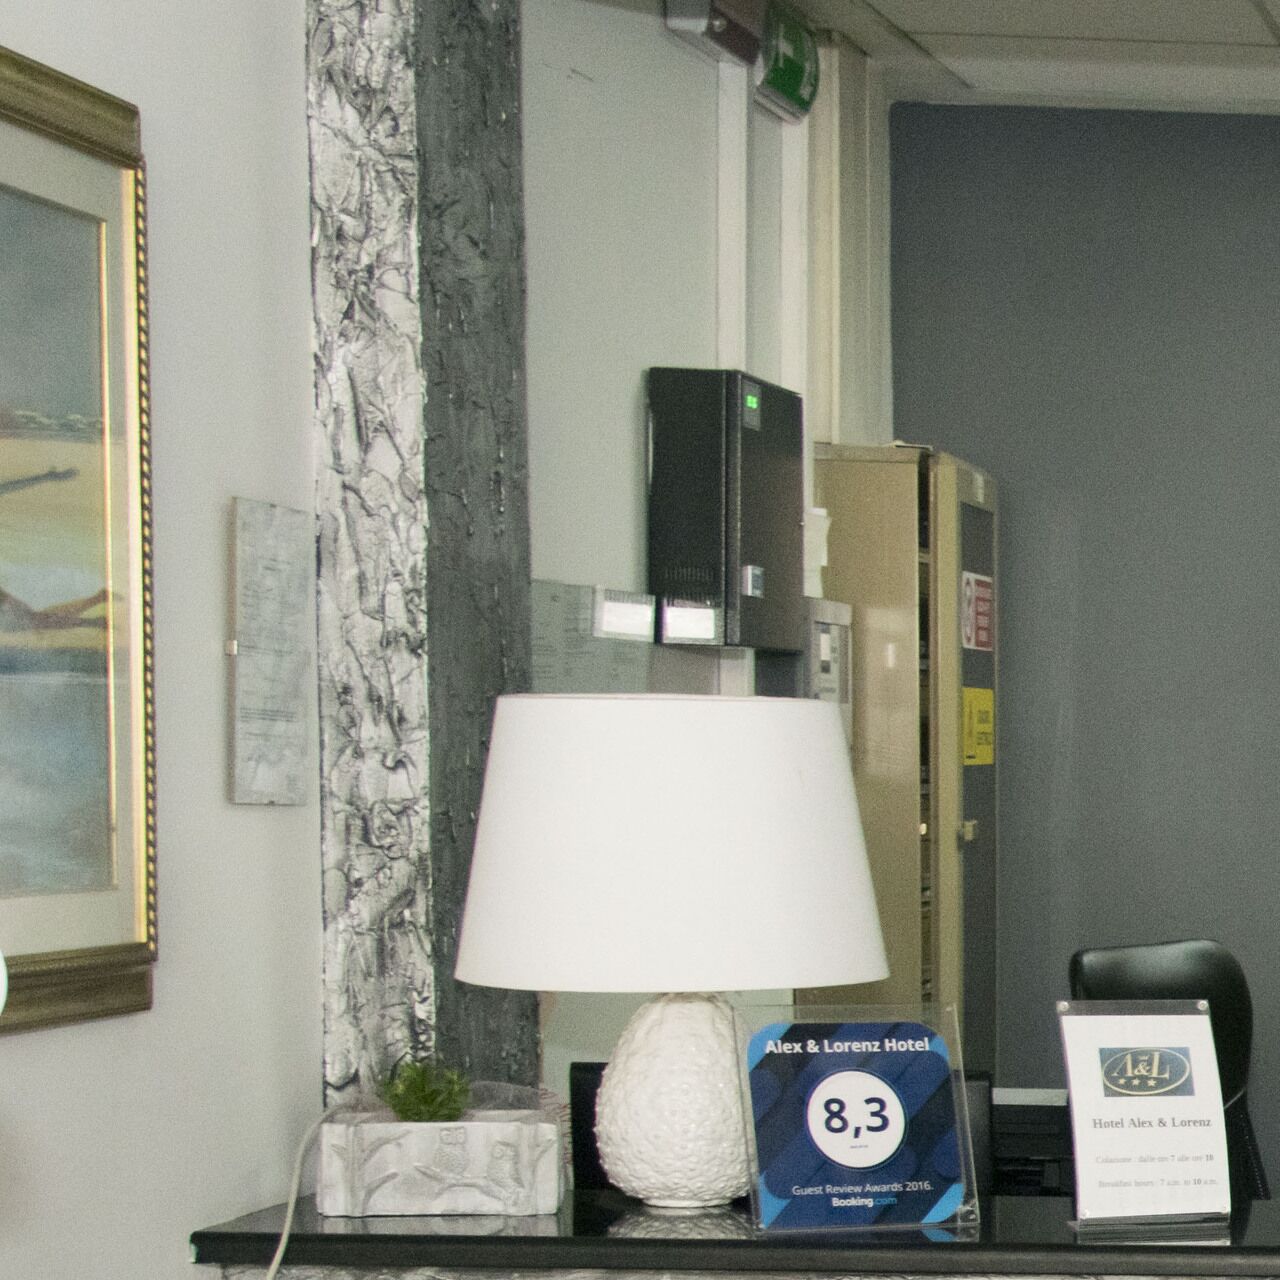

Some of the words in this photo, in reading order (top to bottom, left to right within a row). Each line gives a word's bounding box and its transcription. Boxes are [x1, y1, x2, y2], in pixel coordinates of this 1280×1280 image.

[765, 1039, 803, 1054] Alex
[806, 1039, 820, 1053] &
[825, 1038, 881, 1053] Lorenz
[884, 1036, 930, 1052] Hotel
[823, 1096, 890, 1139] 8,3
[1092, 1117, 1124, 1129] Hotel
[1128, 1117, 1154, 1128] Alex
[1157, 1117, 1168, 1128] &
[1171, 1116, 1212, 1128] Lorenz
[792, 1184, 823, 1196] Guest
[825, 1183, 862, 1194] Review
[864, 1181, 903, 1193] Awards
[1192, 1177, 1203, 1186] 10
